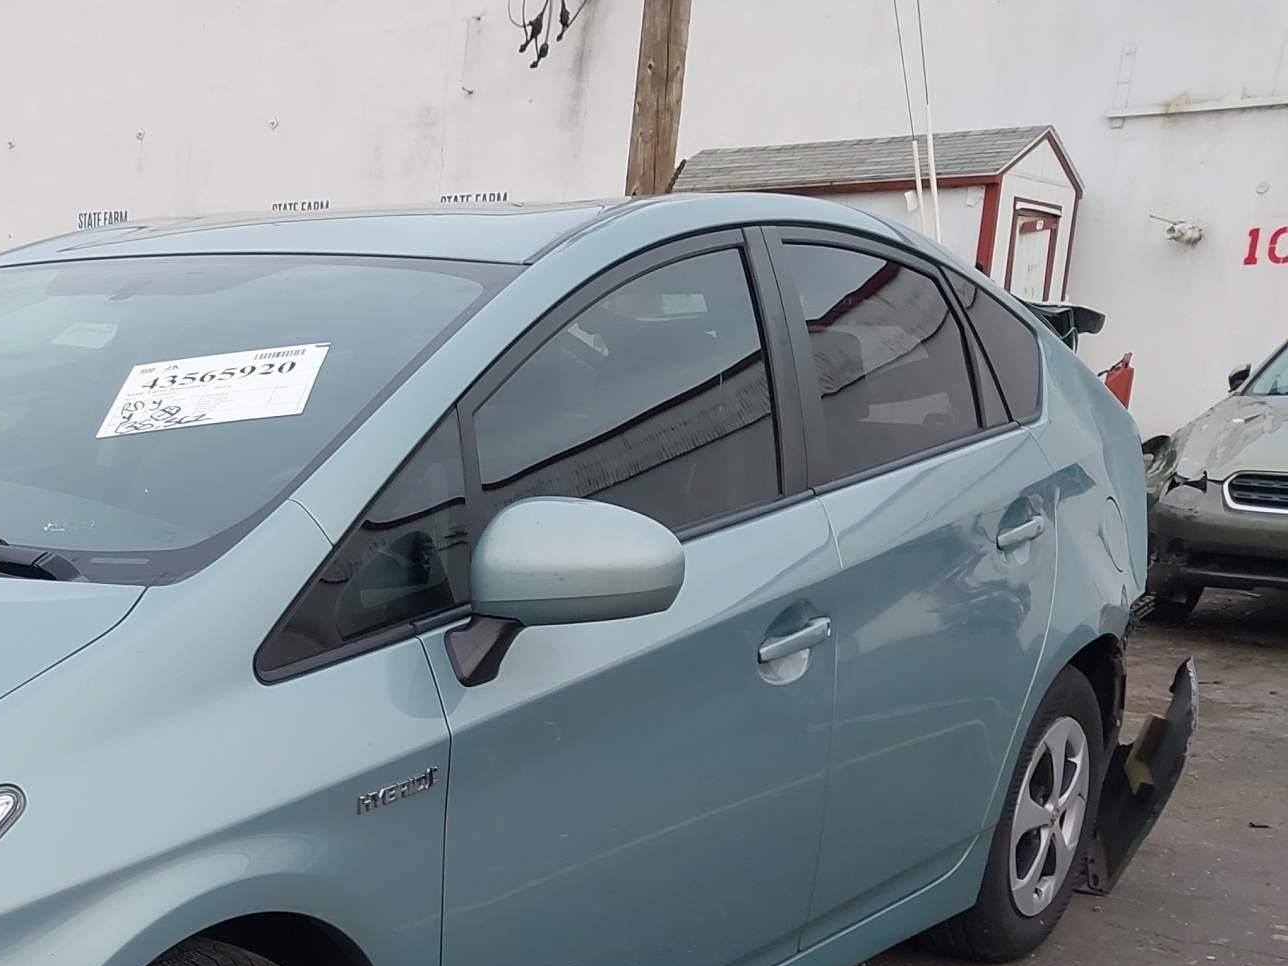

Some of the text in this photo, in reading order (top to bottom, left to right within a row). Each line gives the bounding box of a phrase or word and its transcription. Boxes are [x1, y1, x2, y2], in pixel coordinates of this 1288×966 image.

[78, 210, 128, 229] STATE FARM
[141, 360, 297, 390] 43565920
